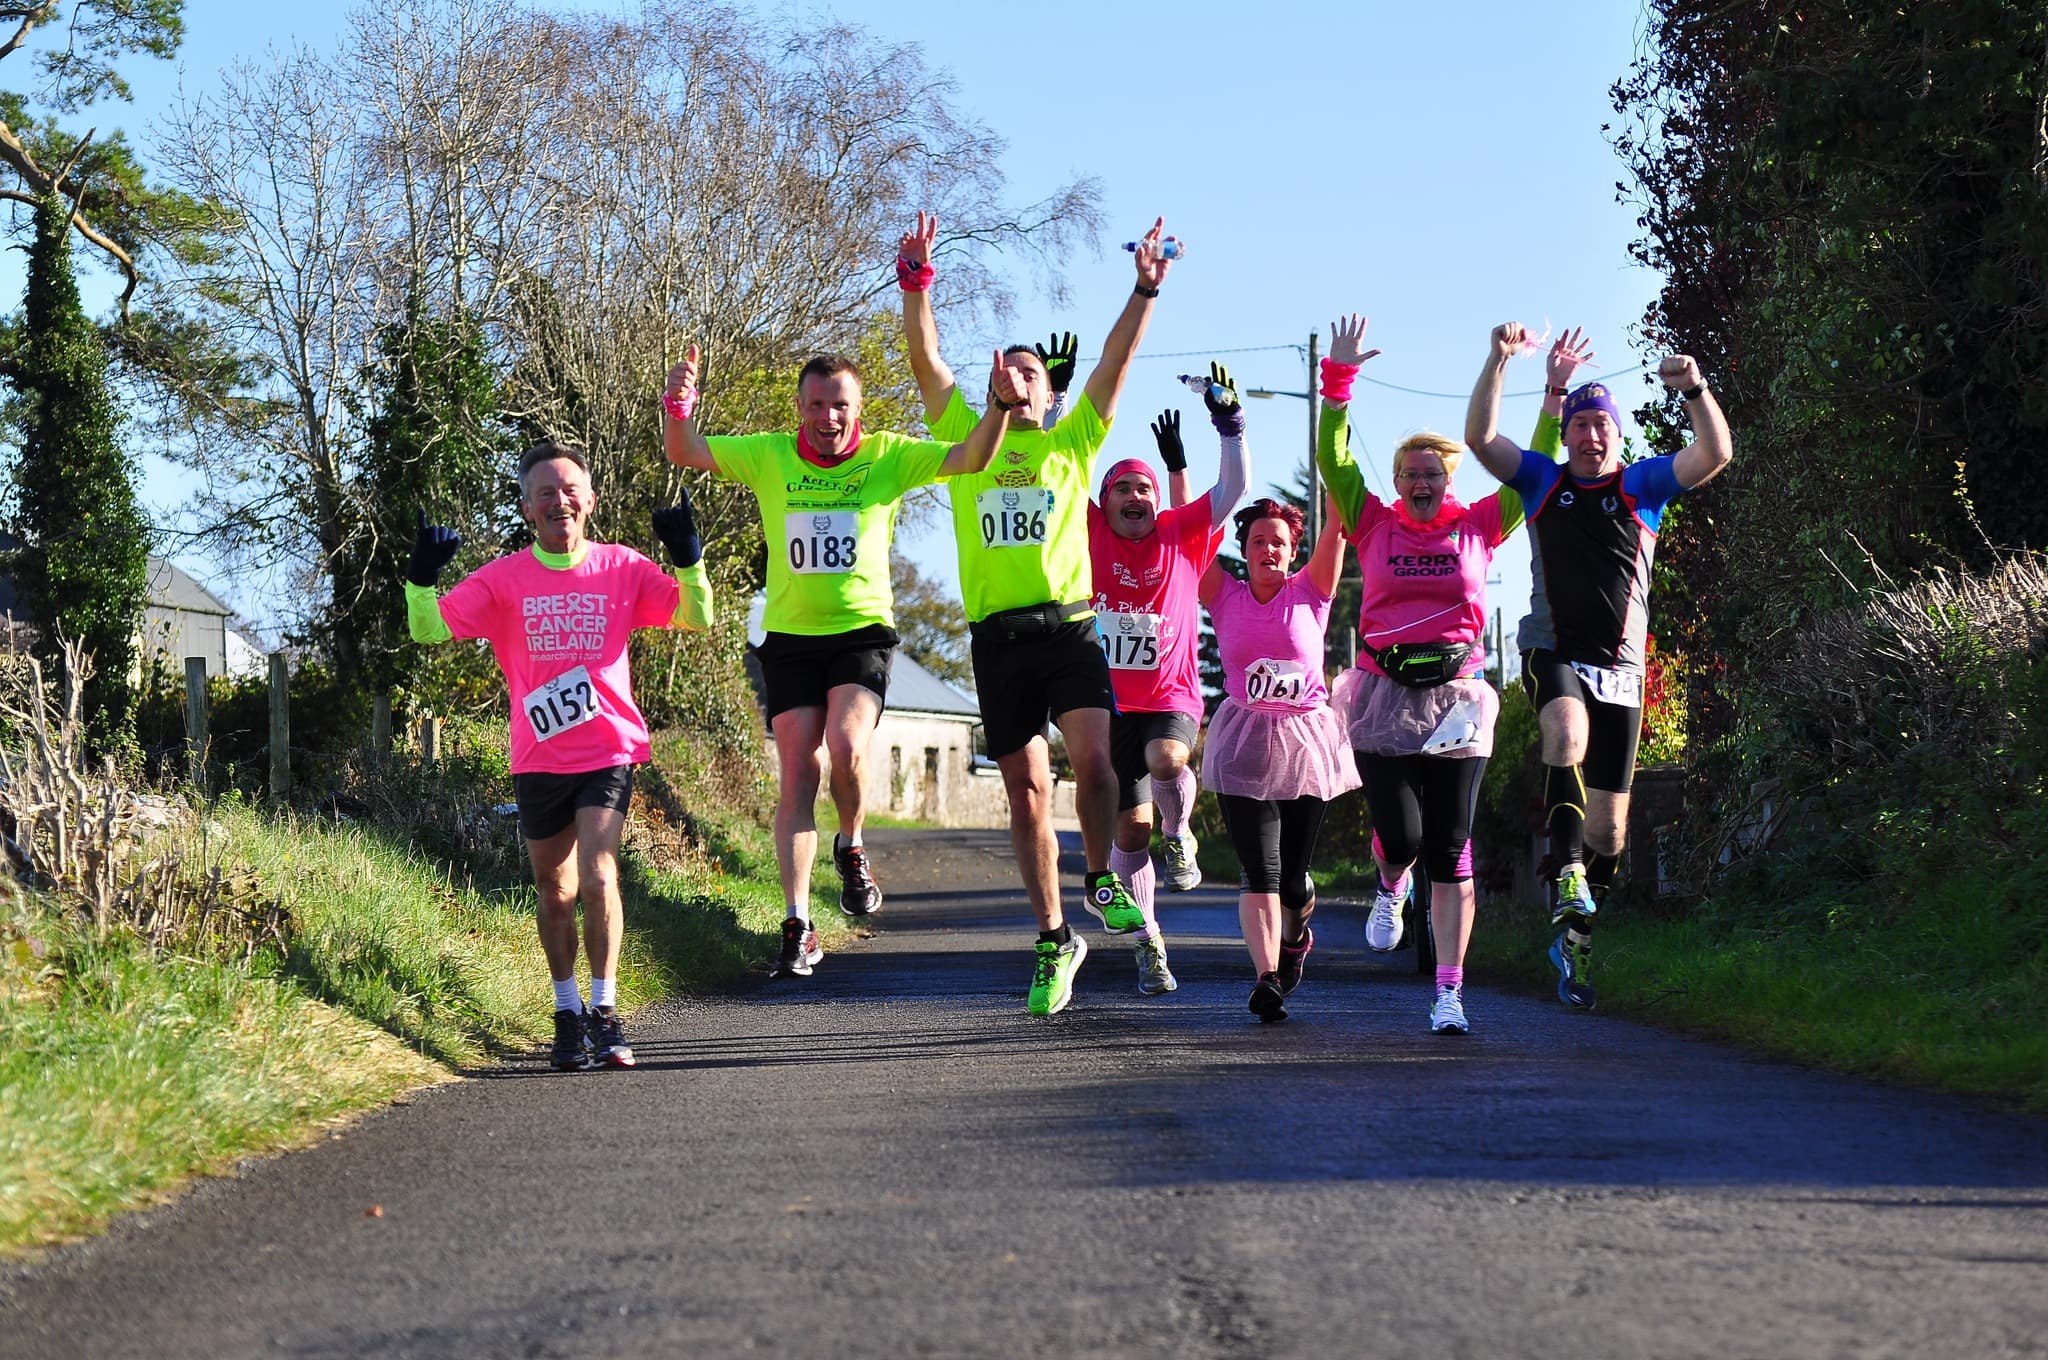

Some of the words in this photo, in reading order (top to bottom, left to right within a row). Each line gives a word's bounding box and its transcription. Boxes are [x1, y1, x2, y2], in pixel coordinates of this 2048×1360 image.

[982, 511, 1045, 543] 0186
[790, 536, 857, 569] 0183
[1387, 554, 1461, 567] KERRY
[1393, 567, 1456, 577] GROUP
[523, 592, 608, 616] BREAST
[1118, 601, 1155, 613] Pink
[525, 614, 608, 635] CANCER
[526, 633, 605, 652] IRELAND
[1101, 633, 1157, 665] 0175
[1248, 673, 1299, 700] 0161
[529, 681, 596, 735] 0152
